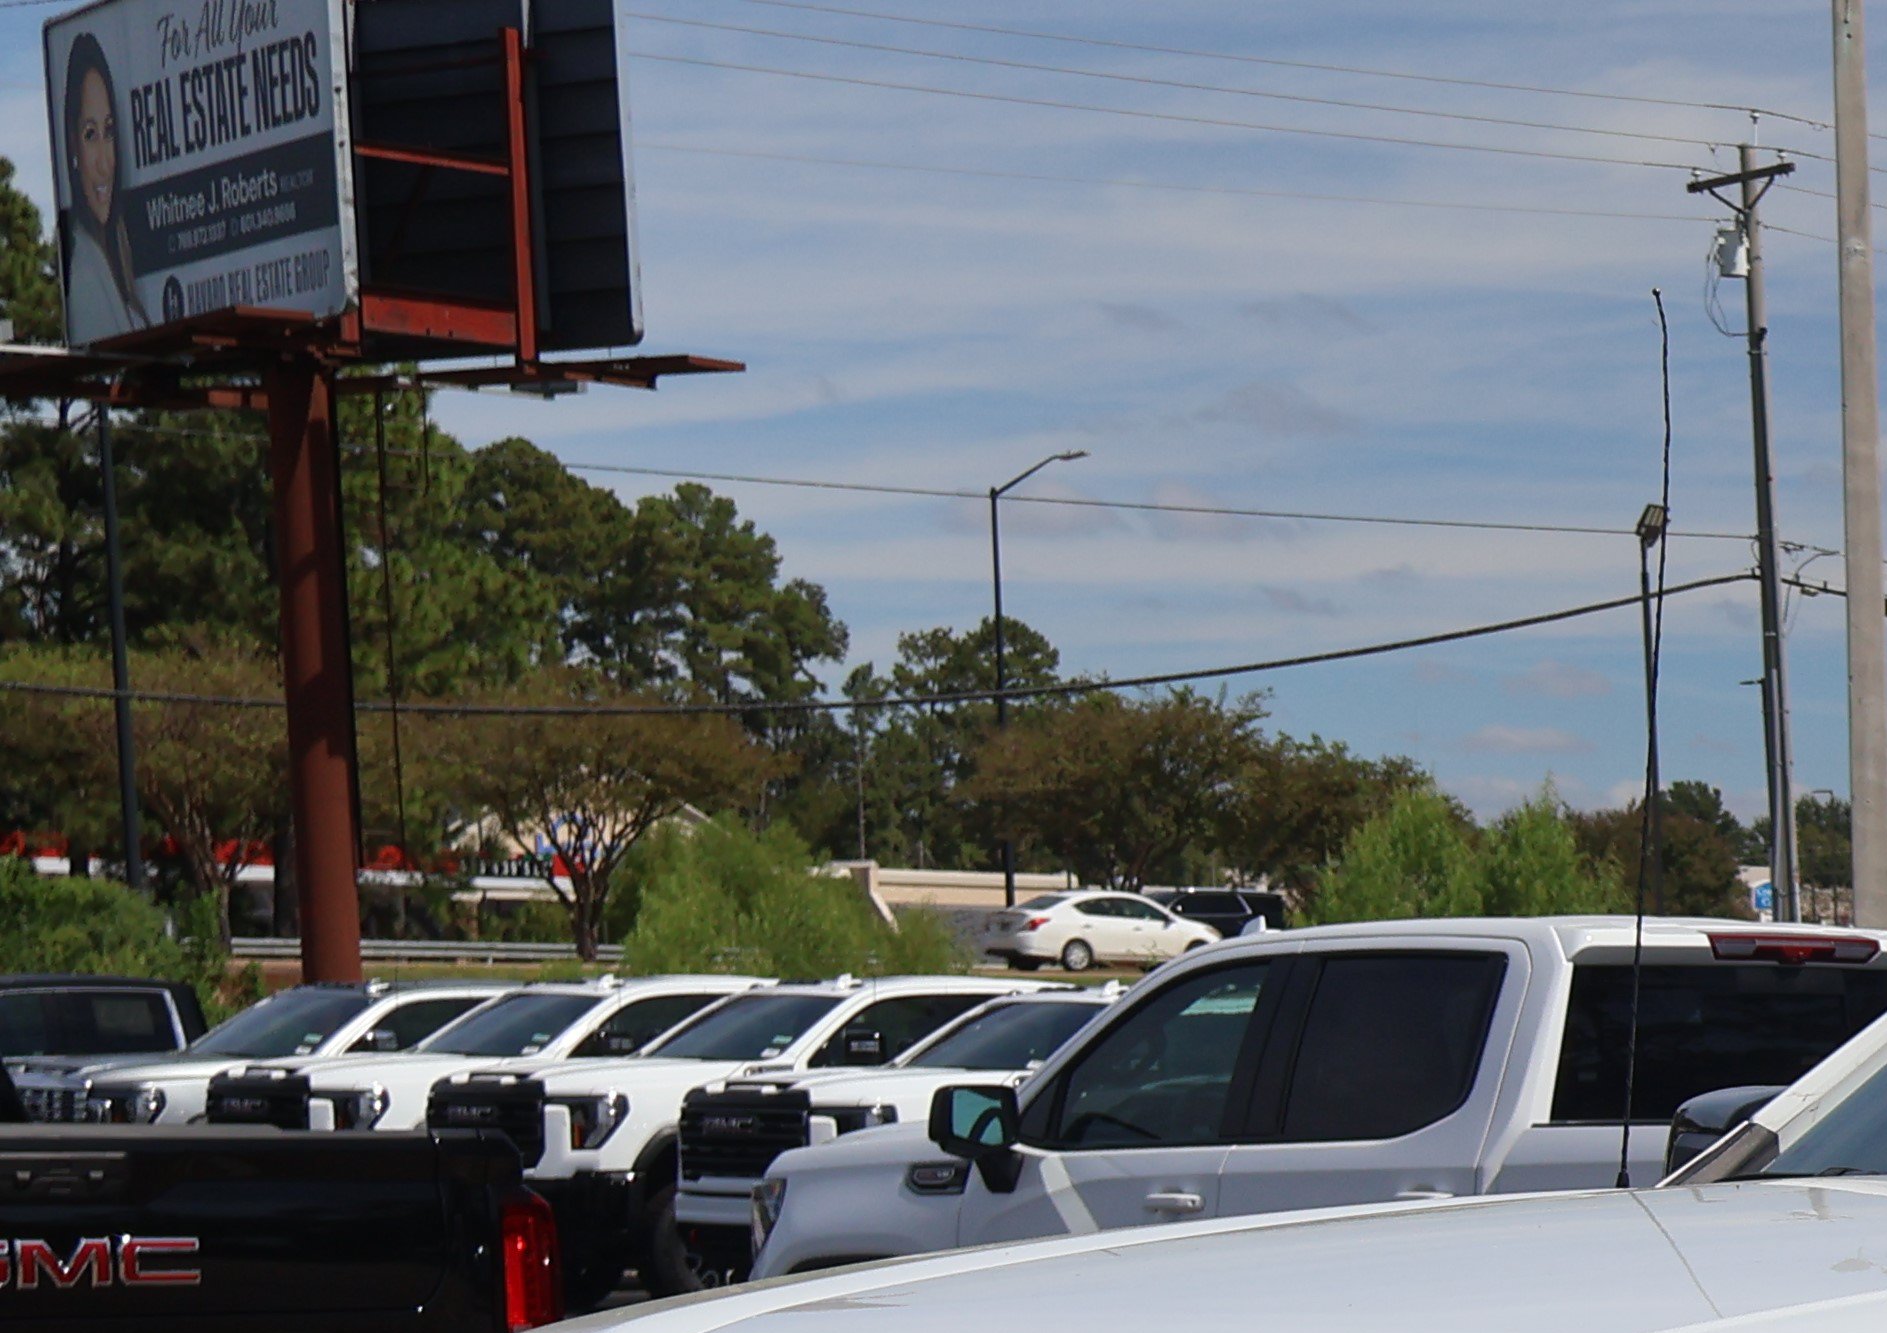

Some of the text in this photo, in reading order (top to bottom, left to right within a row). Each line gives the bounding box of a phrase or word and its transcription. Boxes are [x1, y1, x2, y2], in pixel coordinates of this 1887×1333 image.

[157, 0, 278, 68] For All Your
[130, 31, 320, 169] REAL ESTATE NEEDS
[146, 192, 205, 231] Whitnee
[208, 180, 220, 214] J.
[221, 168, 278, 209] Roberts
[228, 268, 253, 305] REAL
[255, 258, 293, 302] ESTATE
[294, 250, 330, 293] GROUP
[0, 1233, 201, 1290] MC
